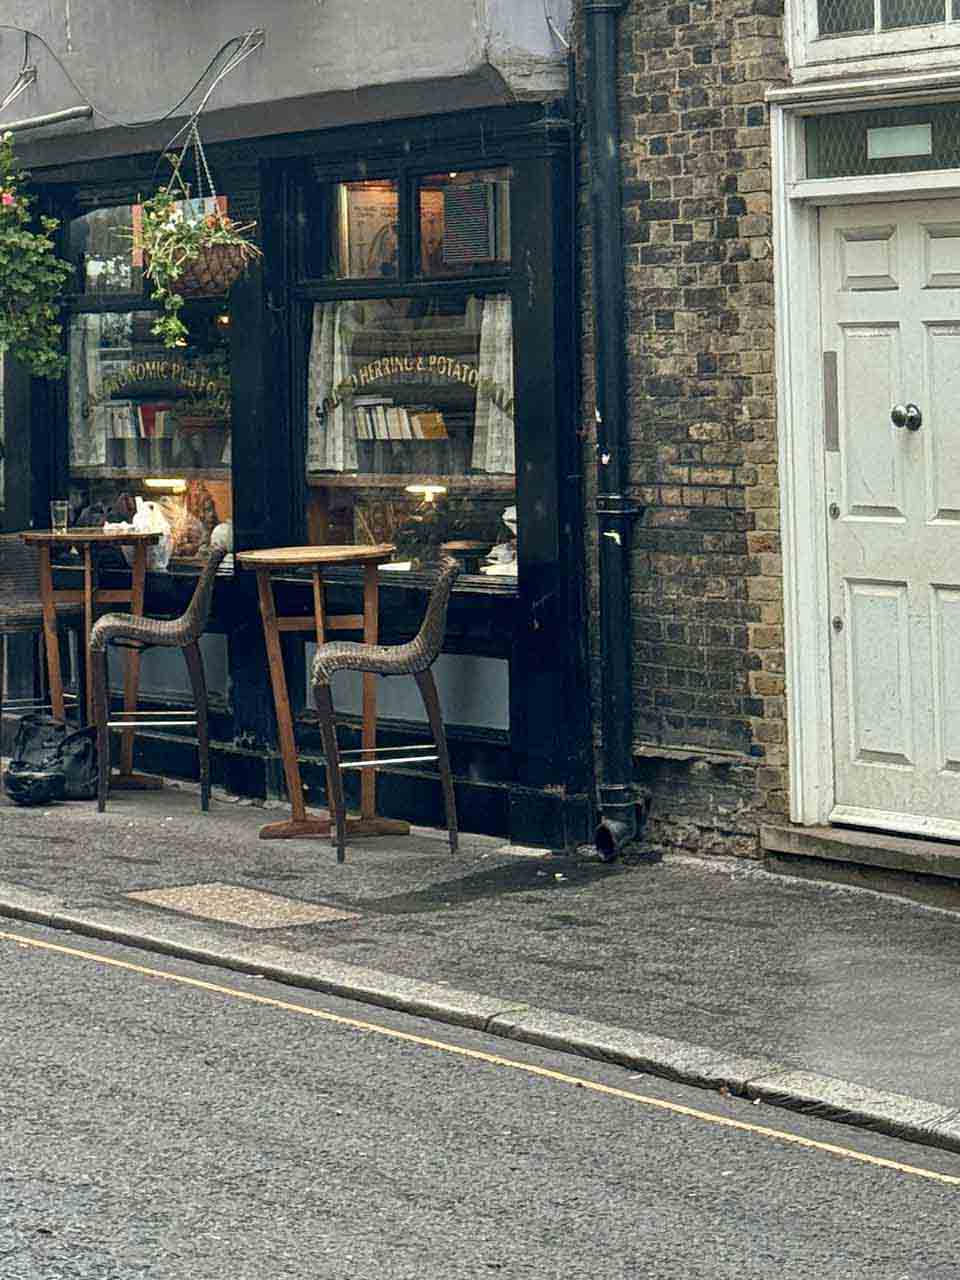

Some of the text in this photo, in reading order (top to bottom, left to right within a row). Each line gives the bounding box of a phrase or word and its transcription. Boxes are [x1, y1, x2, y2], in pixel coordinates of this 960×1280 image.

[359, 355, 411, 386] HERRING
[415, 356, 428, 371] &
[428, 354, 479, 388] POTATO
